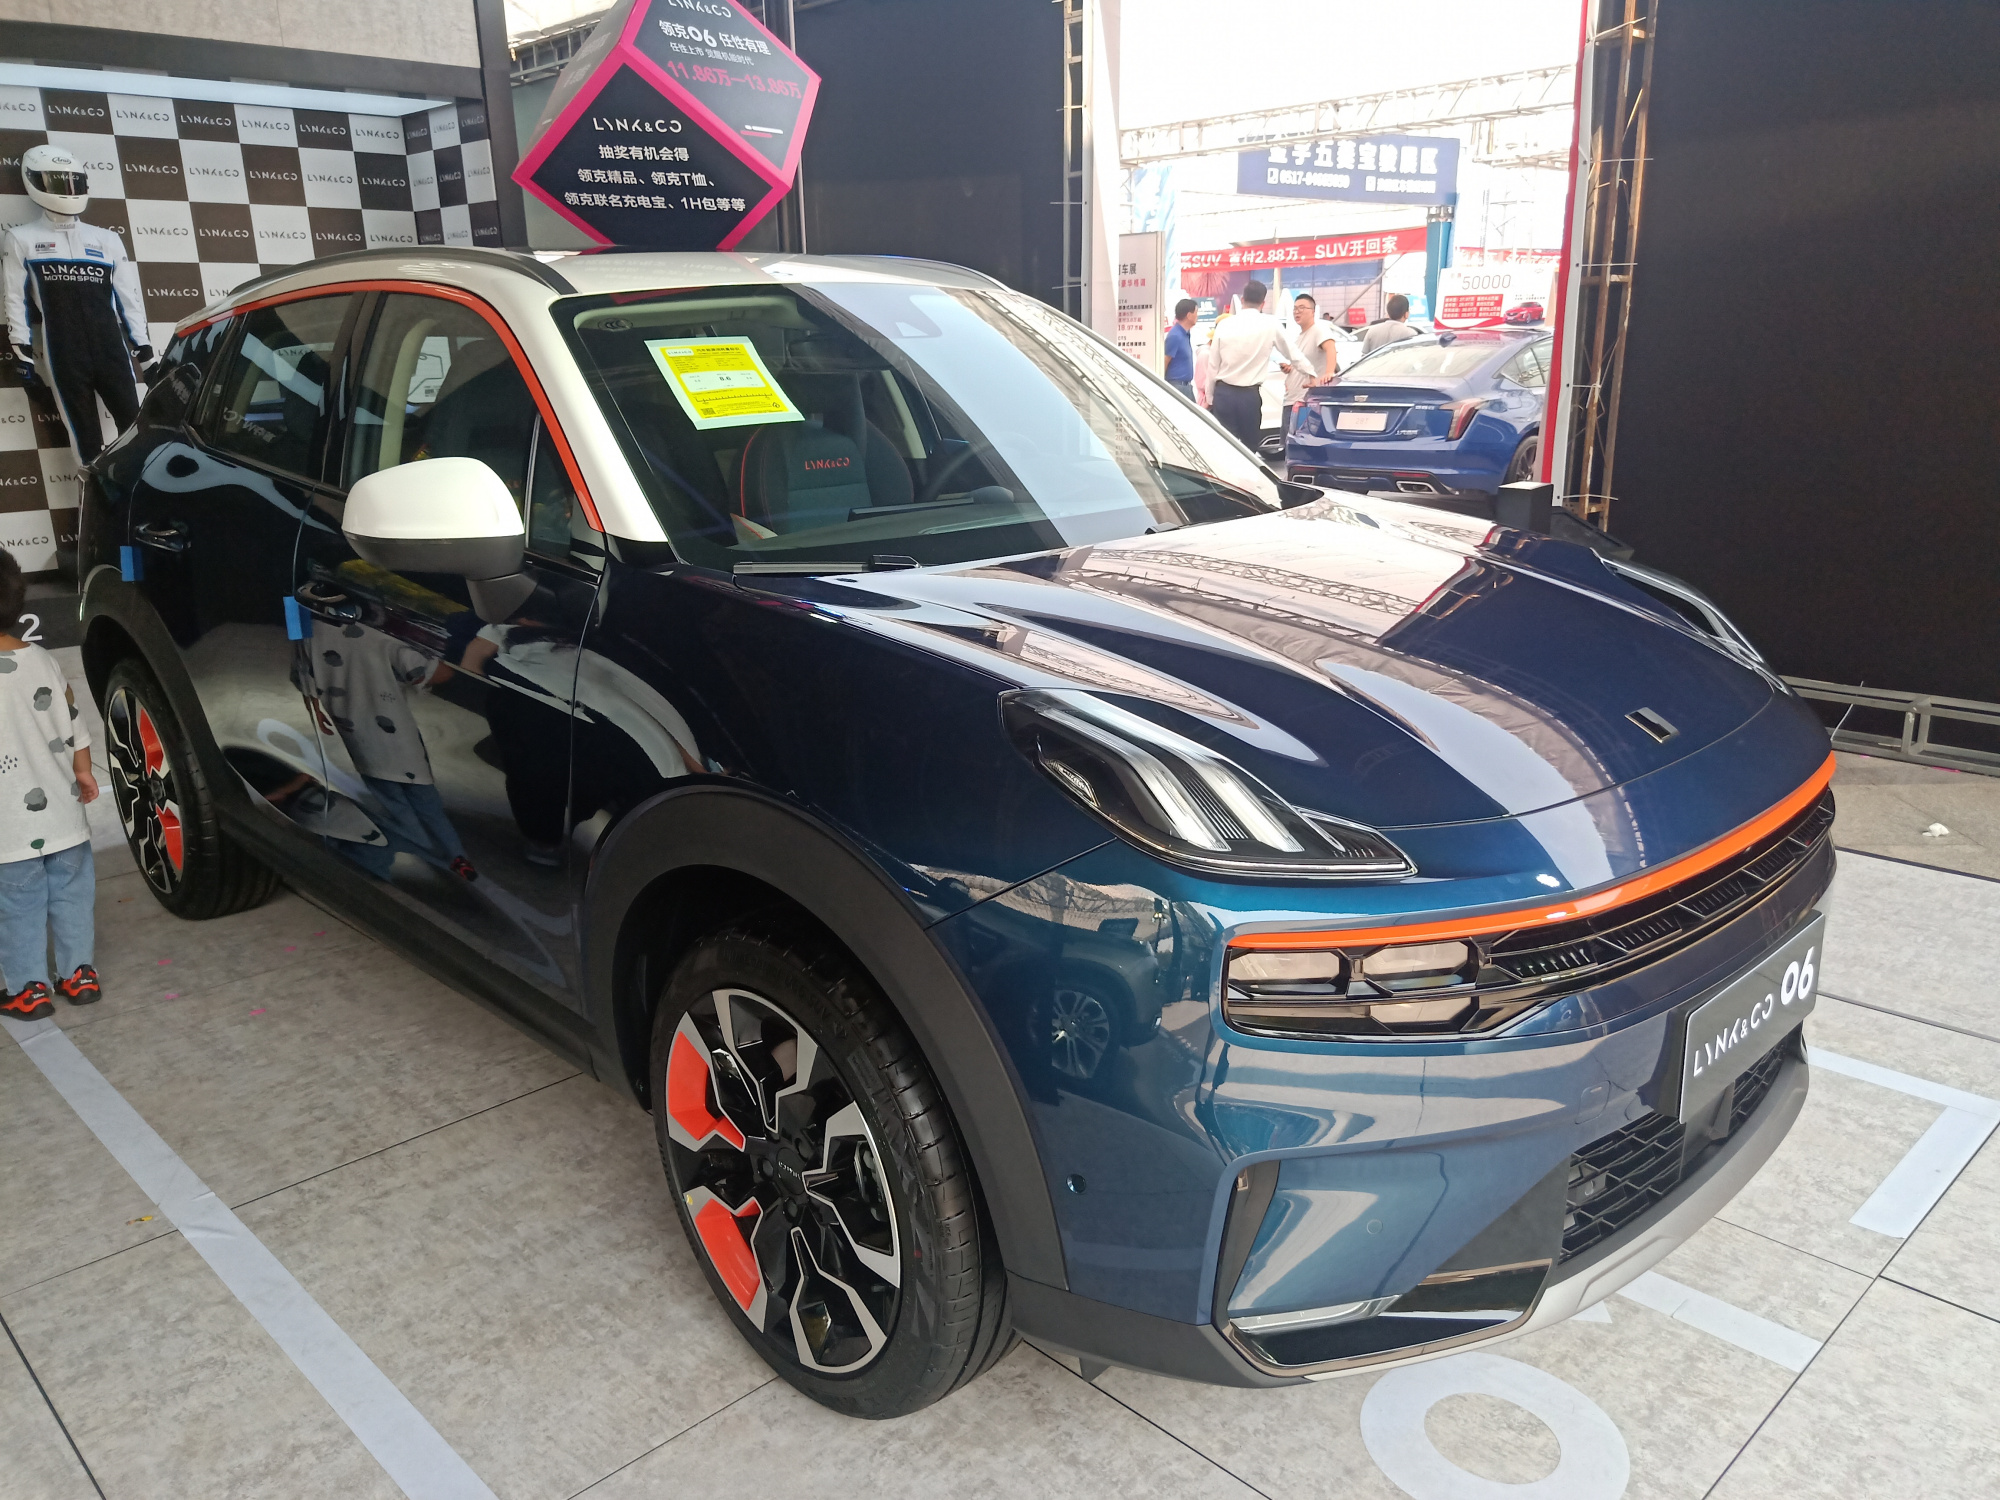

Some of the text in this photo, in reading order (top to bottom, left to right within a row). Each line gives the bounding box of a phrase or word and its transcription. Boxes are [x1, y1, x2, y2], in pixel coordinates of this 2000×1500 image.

[658, 20, 771, 56] 领克06 任性有理
[48, 105, 105, 117] LYNK&CO
[116, 109, 170, 122] LYNK&CO
[180, 114, 232, 126] LYNK&CO
[242, 119, 290, 131] LYNK&CO
[300, 123, 347, 135] LYNK&CO
[355, 128, 400, 140] LYNK&CO
[592, 117, 682, 133] LYNK&CO
[599, 144, 690, 162] 抽奖有机会得
[125, 163, 179, 174] LYNK&CO
[189, 167, 240, 178] LYNK&CO
[249, 170, 298, 181] LYNK&CO
[307, 173, 353, 184] LYNK&CO
[362, 178, 406, 188] LYNK&CO
[577, 168, 716, 188] 领克精品、领克T恤、
[564, 191, 747, 213] 领克联名充电宝、1H包等等
[136, 226, 189, 236] LYNK&CO
[199, 228, 249, 238] LYNK&CO
[259, 230, 307, 240] LYNK&CO
[316, 232, 361, 242] LYNK&CO
[370, 233, 413, 243] LYNK&CO
[41, 264, 105, 277] LYNK&CO
[44, 275, 104, 284] MOTORSPORT
[1462, 274, 1512, 290] 50000
[147, 288, 199, 297] LYNK&CO
[804, 457, 850, 470] LYNK&CO
[1693, 945, 1815, 1078] LYNK&CO 06
